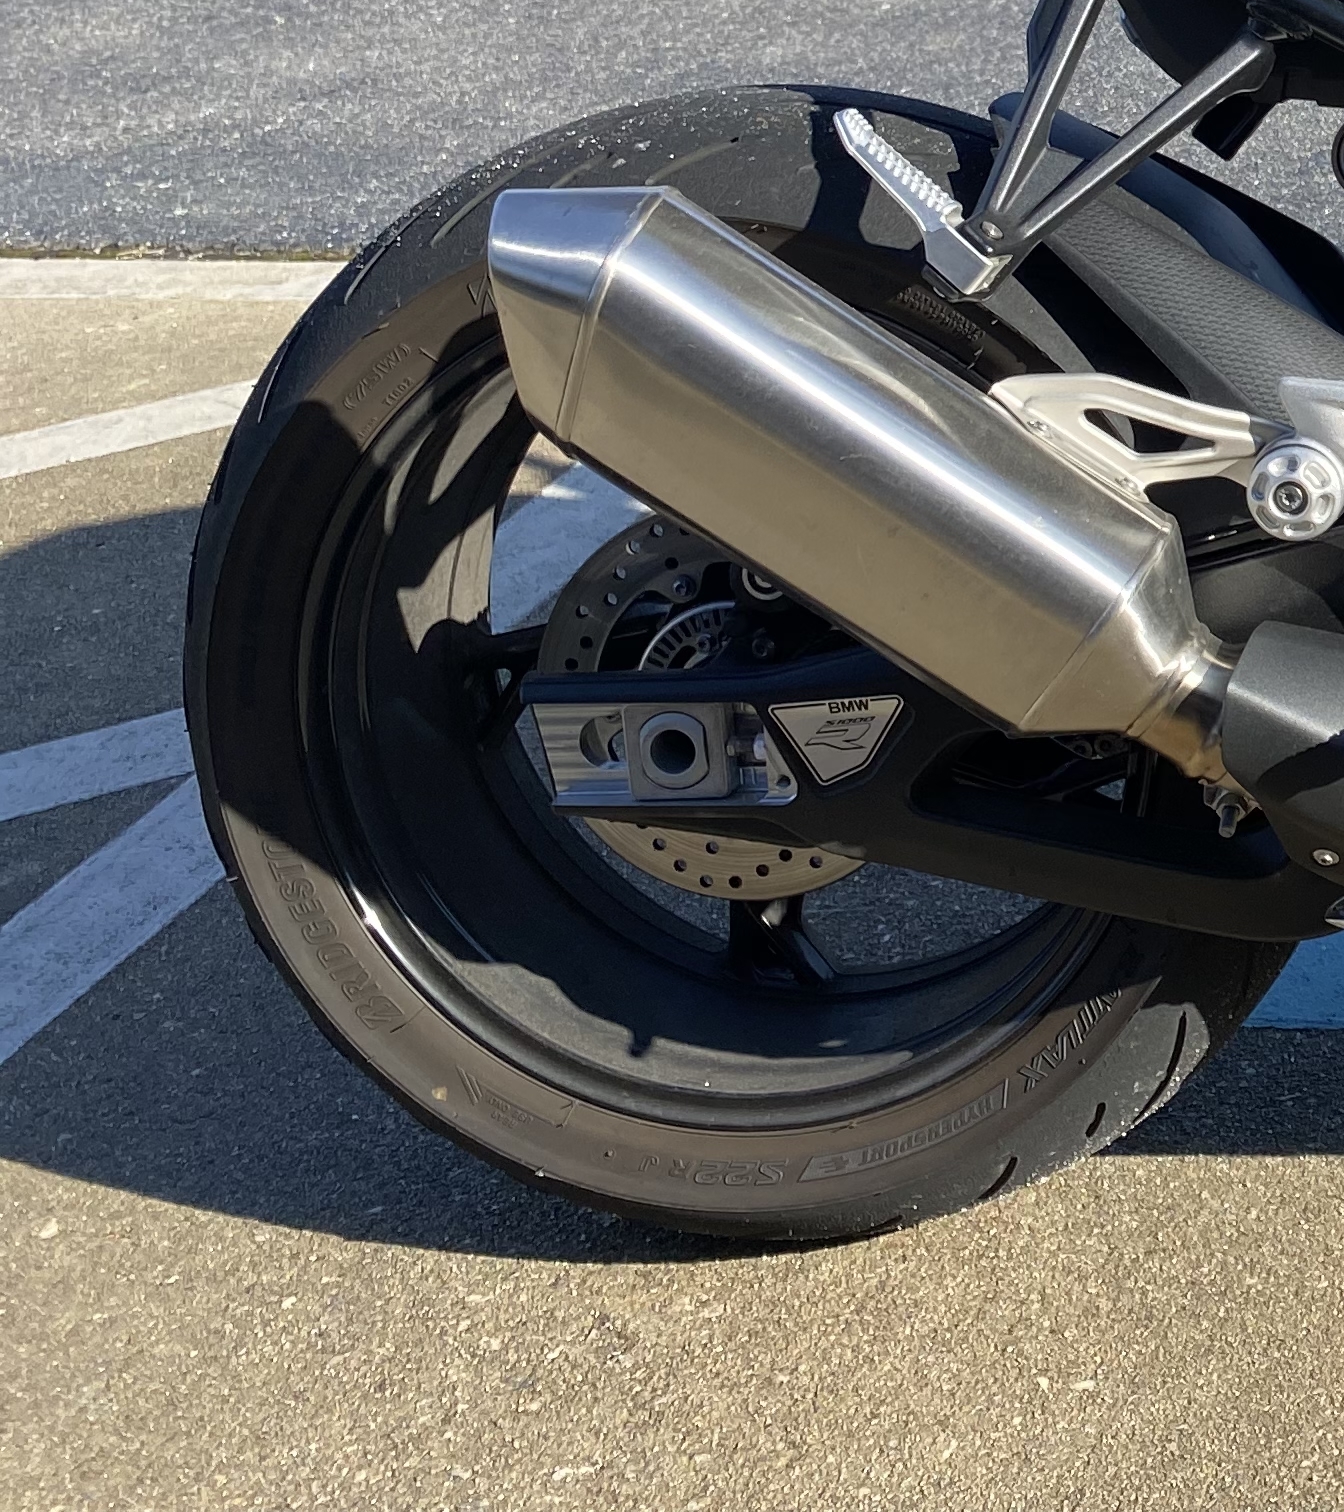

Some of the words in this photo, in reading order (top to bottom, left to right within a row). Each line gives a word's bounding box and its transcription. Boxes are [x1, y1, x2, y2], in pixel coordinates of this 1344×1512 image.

[828, 699, 870, 714] BMW
[826, 716, 876, 725] S1000
[858, 1095, 994, 1167] HYPERSPORT
